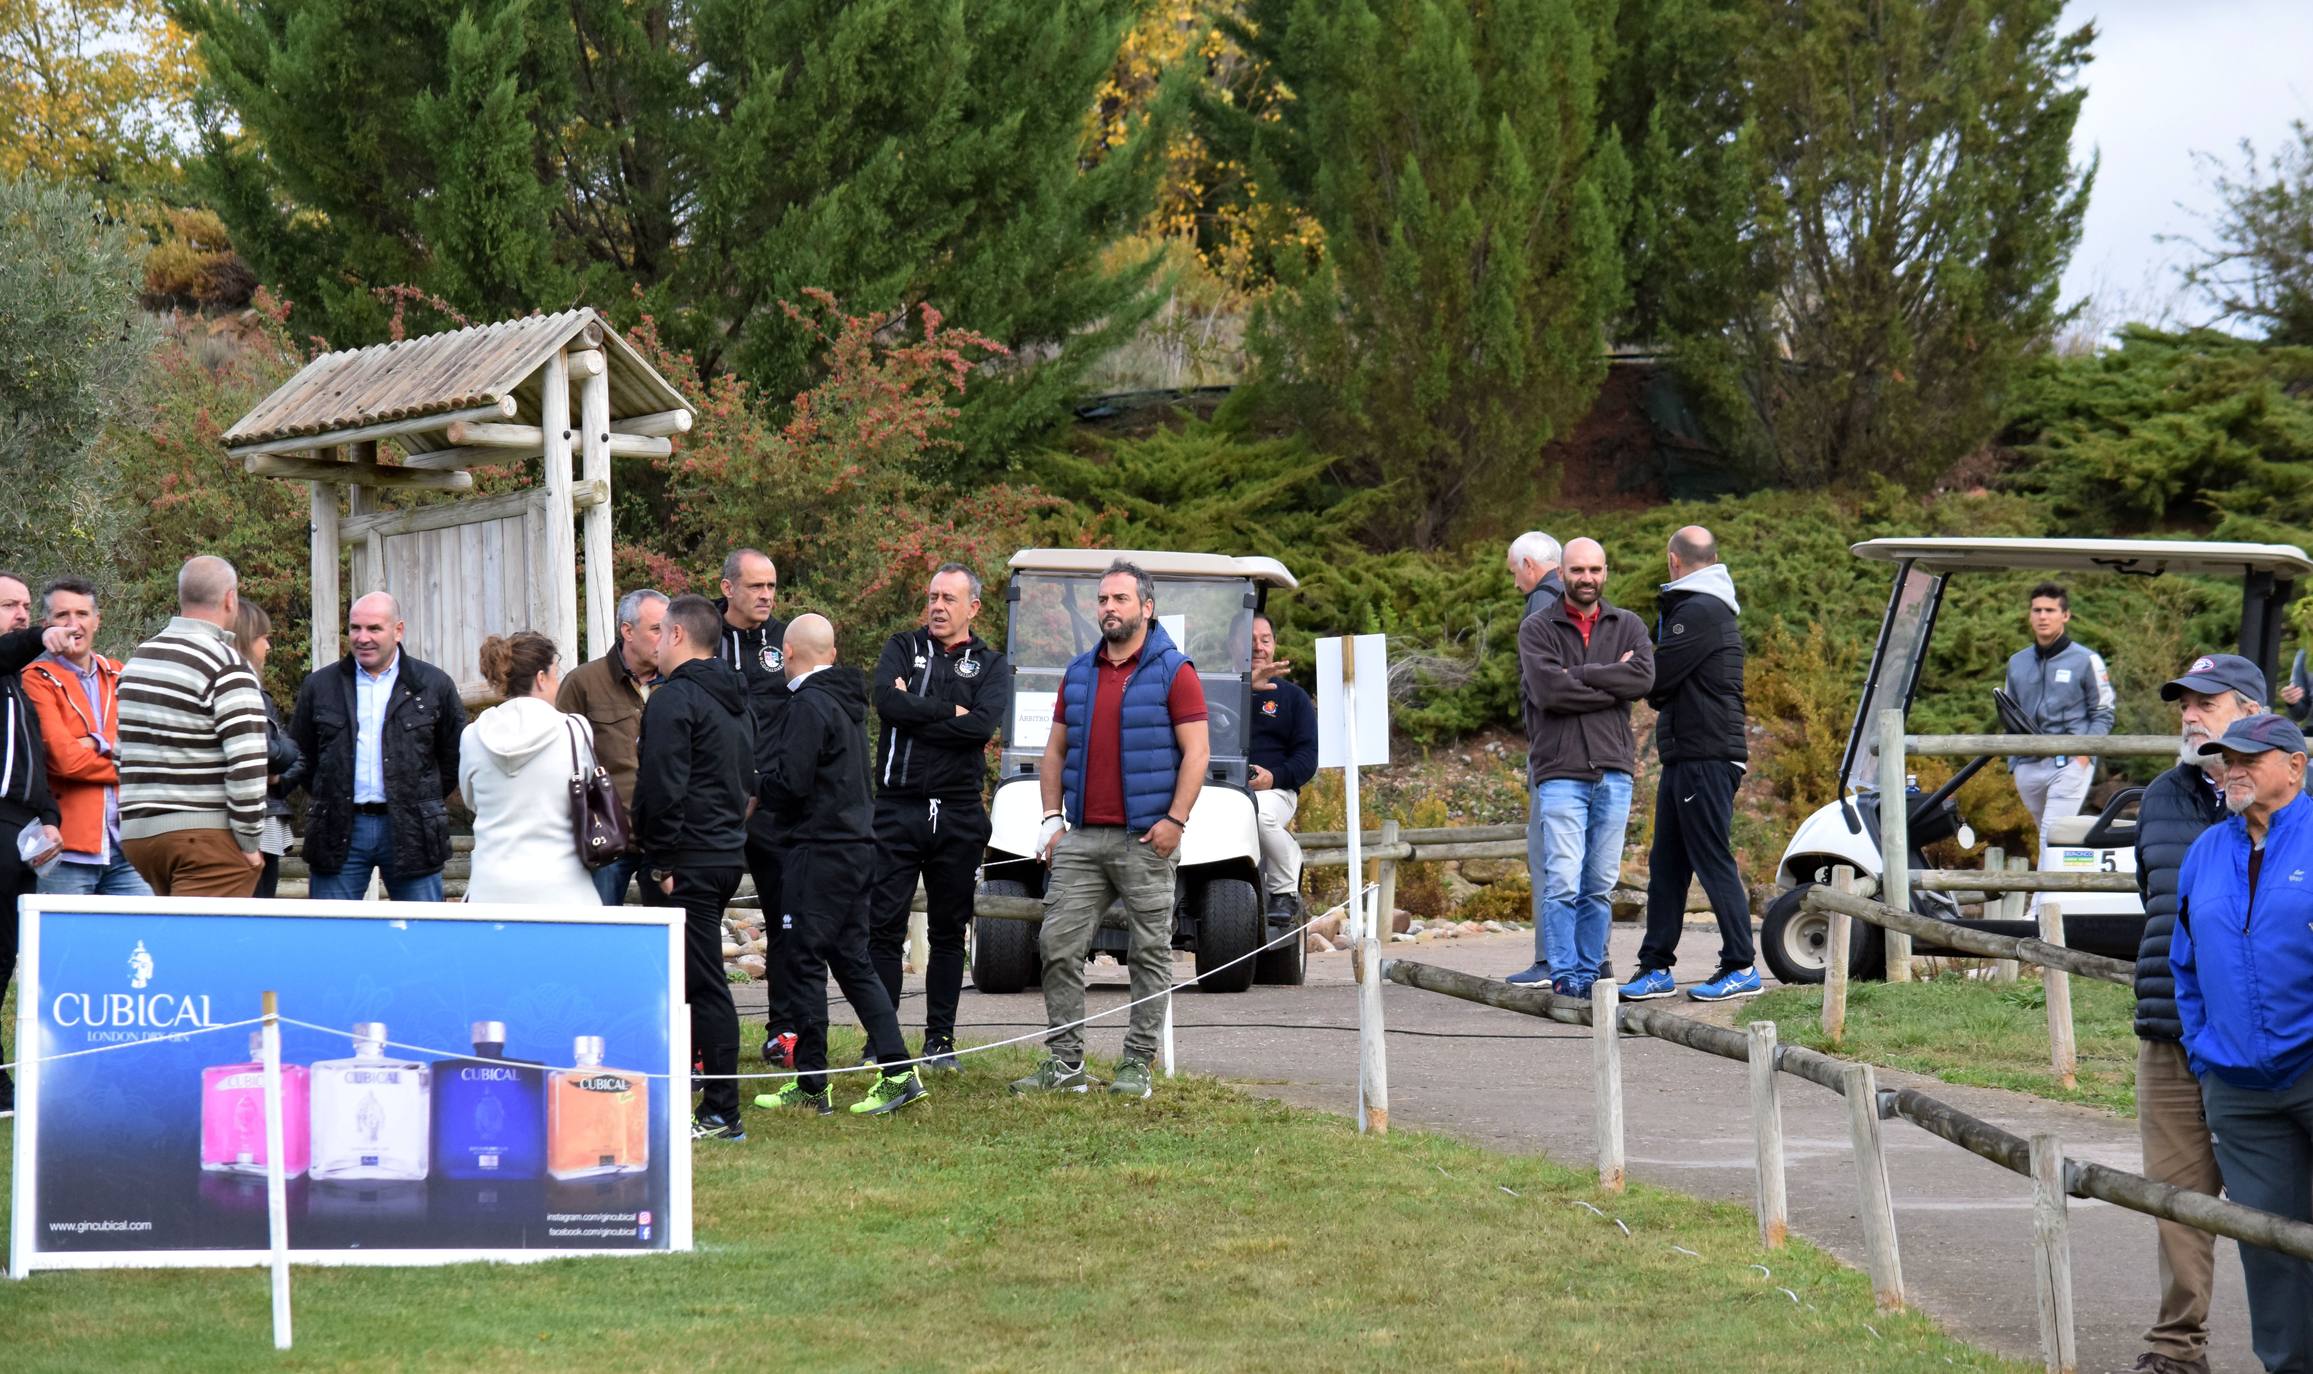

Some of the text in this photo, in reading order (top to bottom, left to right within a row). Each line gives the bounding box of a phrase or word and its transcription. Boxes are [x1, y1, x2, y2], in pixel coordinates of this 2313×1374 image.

[2100, 850, 2117, 872] 5
[53, 992, 224, 1028] CUBICAL
[87, 1031, 139, 1043] LONDON
[344, 1071, 402, 1085] CUBICAL
[461, 1067, 520, 1082] CUBICAL
[227, 1075, 265, 1089] CUBIC
[579, 1078, 629, 1091] CUBICAL
[546, 1213, 637, 1223] instagram.com/gincubical
[49, 1220, 153, 1234] www.gincubical.com
[548, 1227, 637, 1238] facebook.com/gincubical
